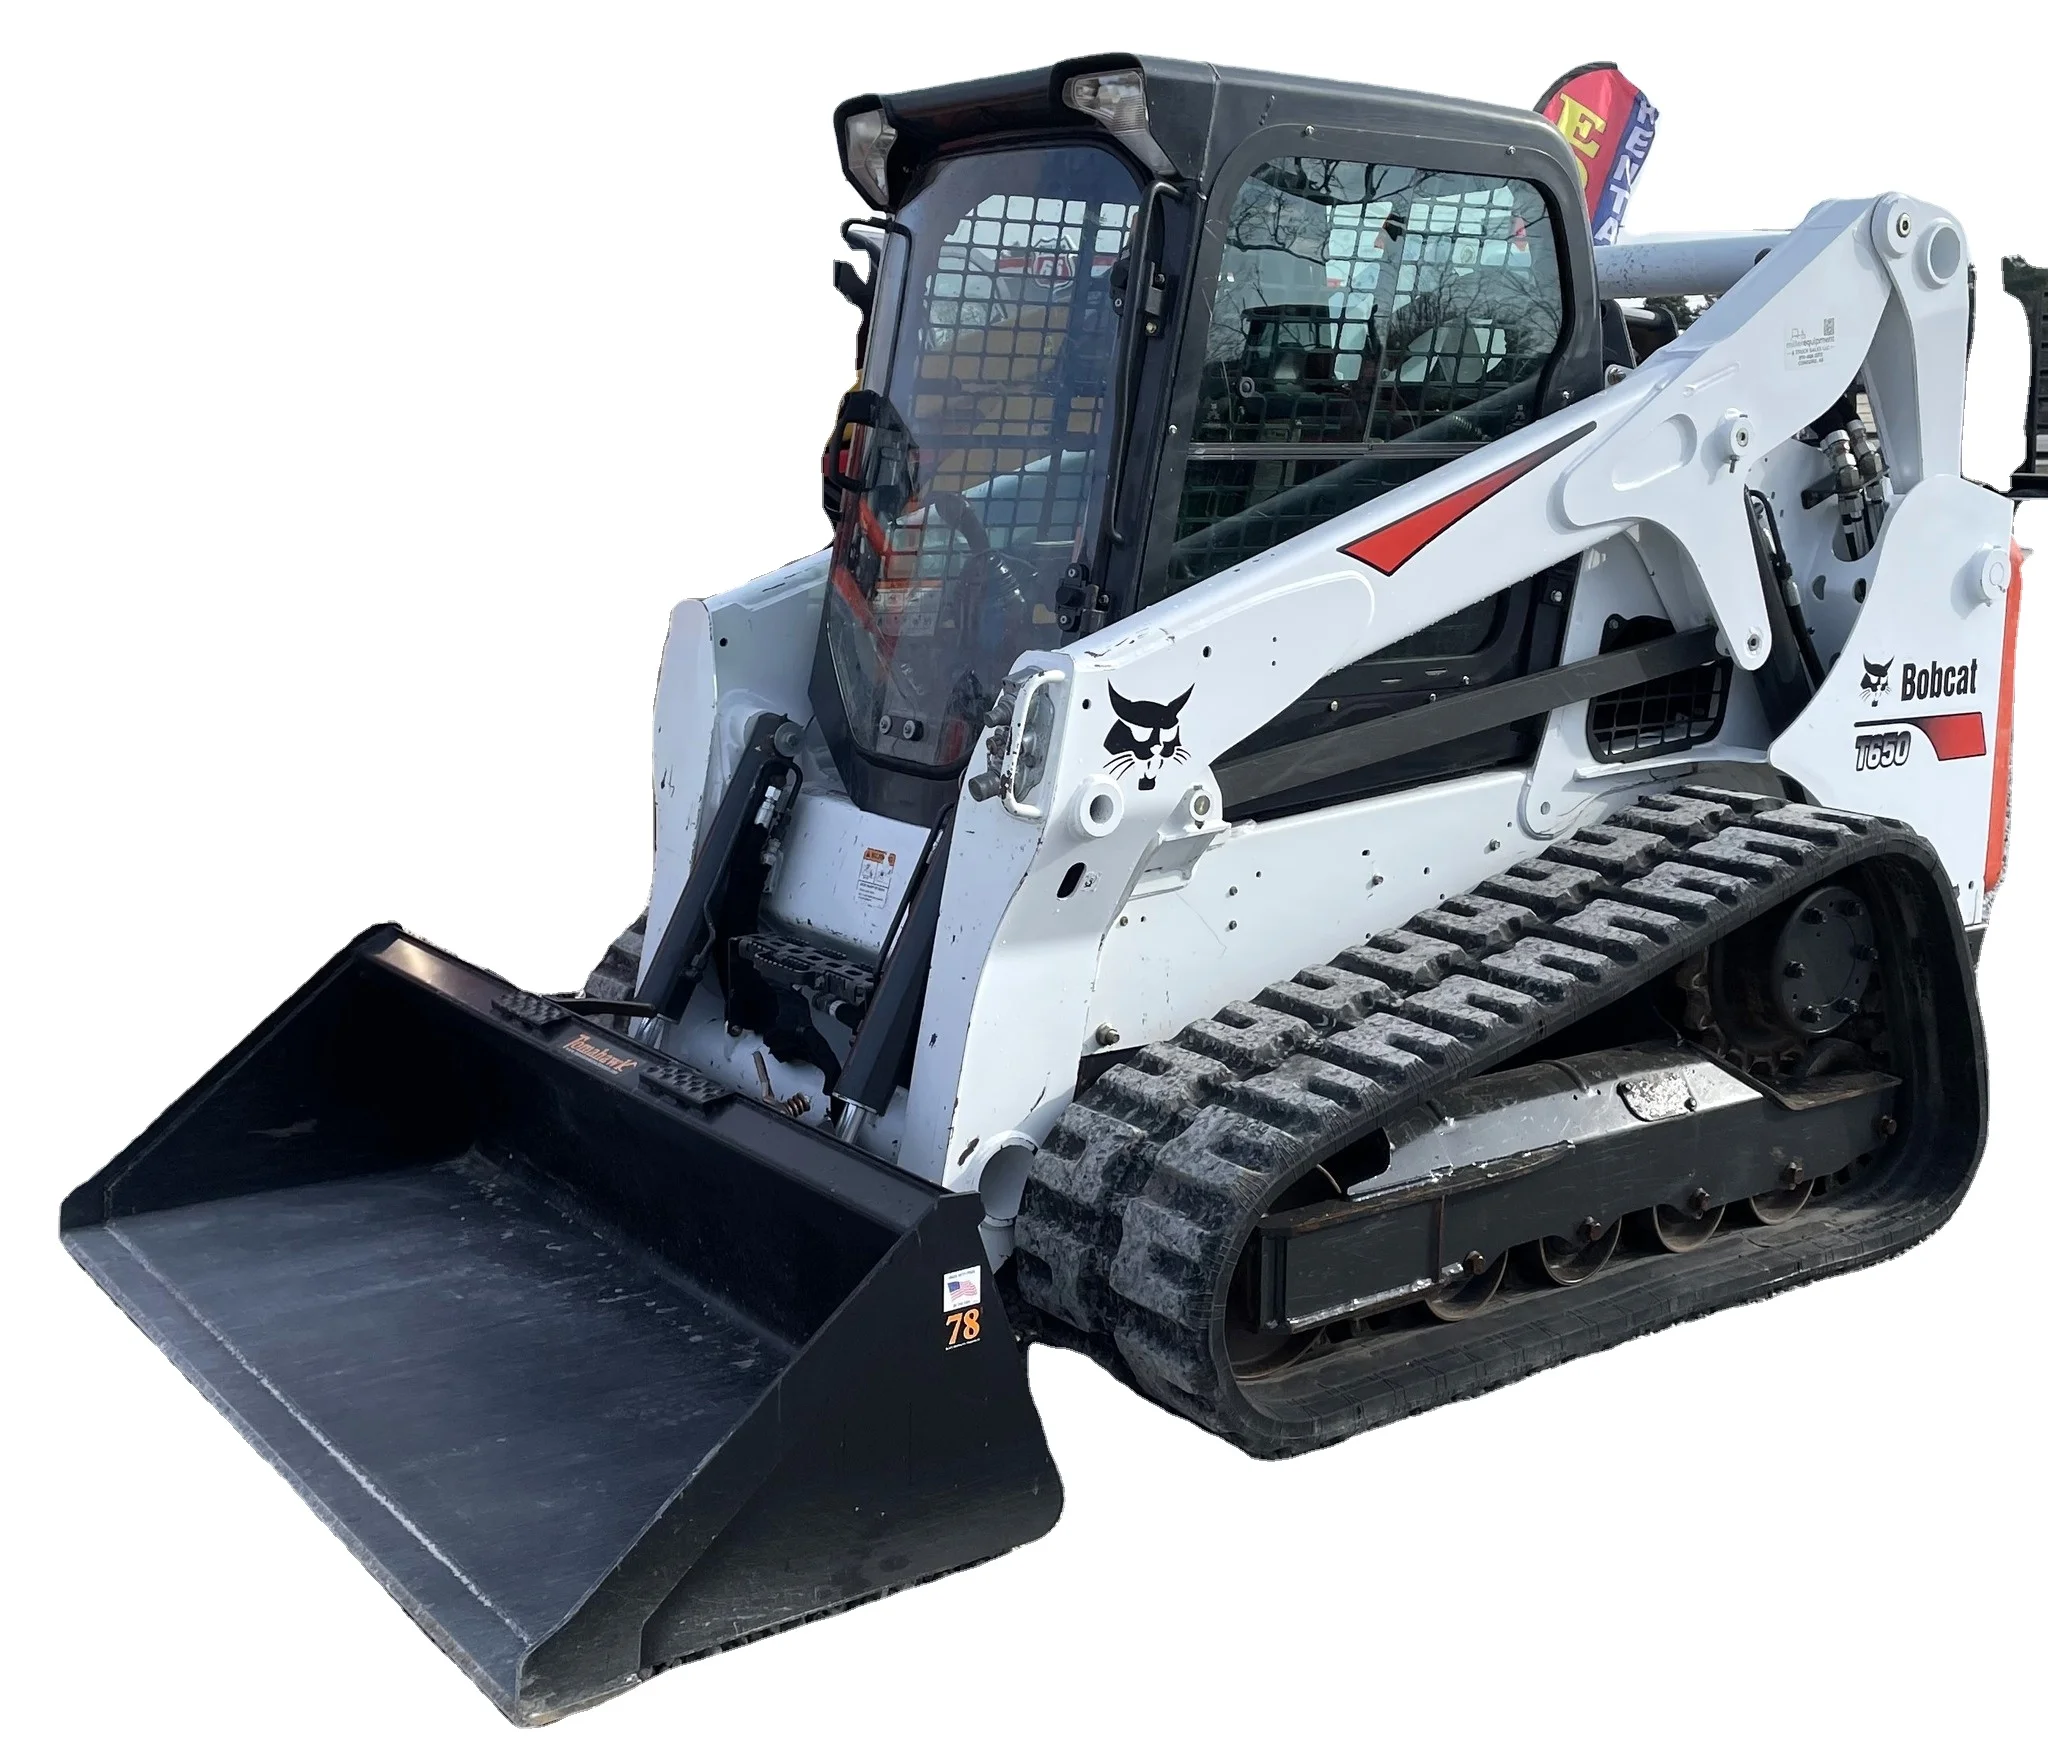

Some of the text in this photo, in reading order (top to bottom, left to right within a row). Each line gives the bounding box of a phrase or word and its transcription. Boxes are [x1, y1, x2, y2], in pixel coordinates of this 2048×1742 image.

[1901, 658, 1978, 701] Bobcat
[1855, 731, 1911, 771] T650
[563, 1032, 638, 1072] Tomahawk
[945, 1308, 980, 1345] 78
